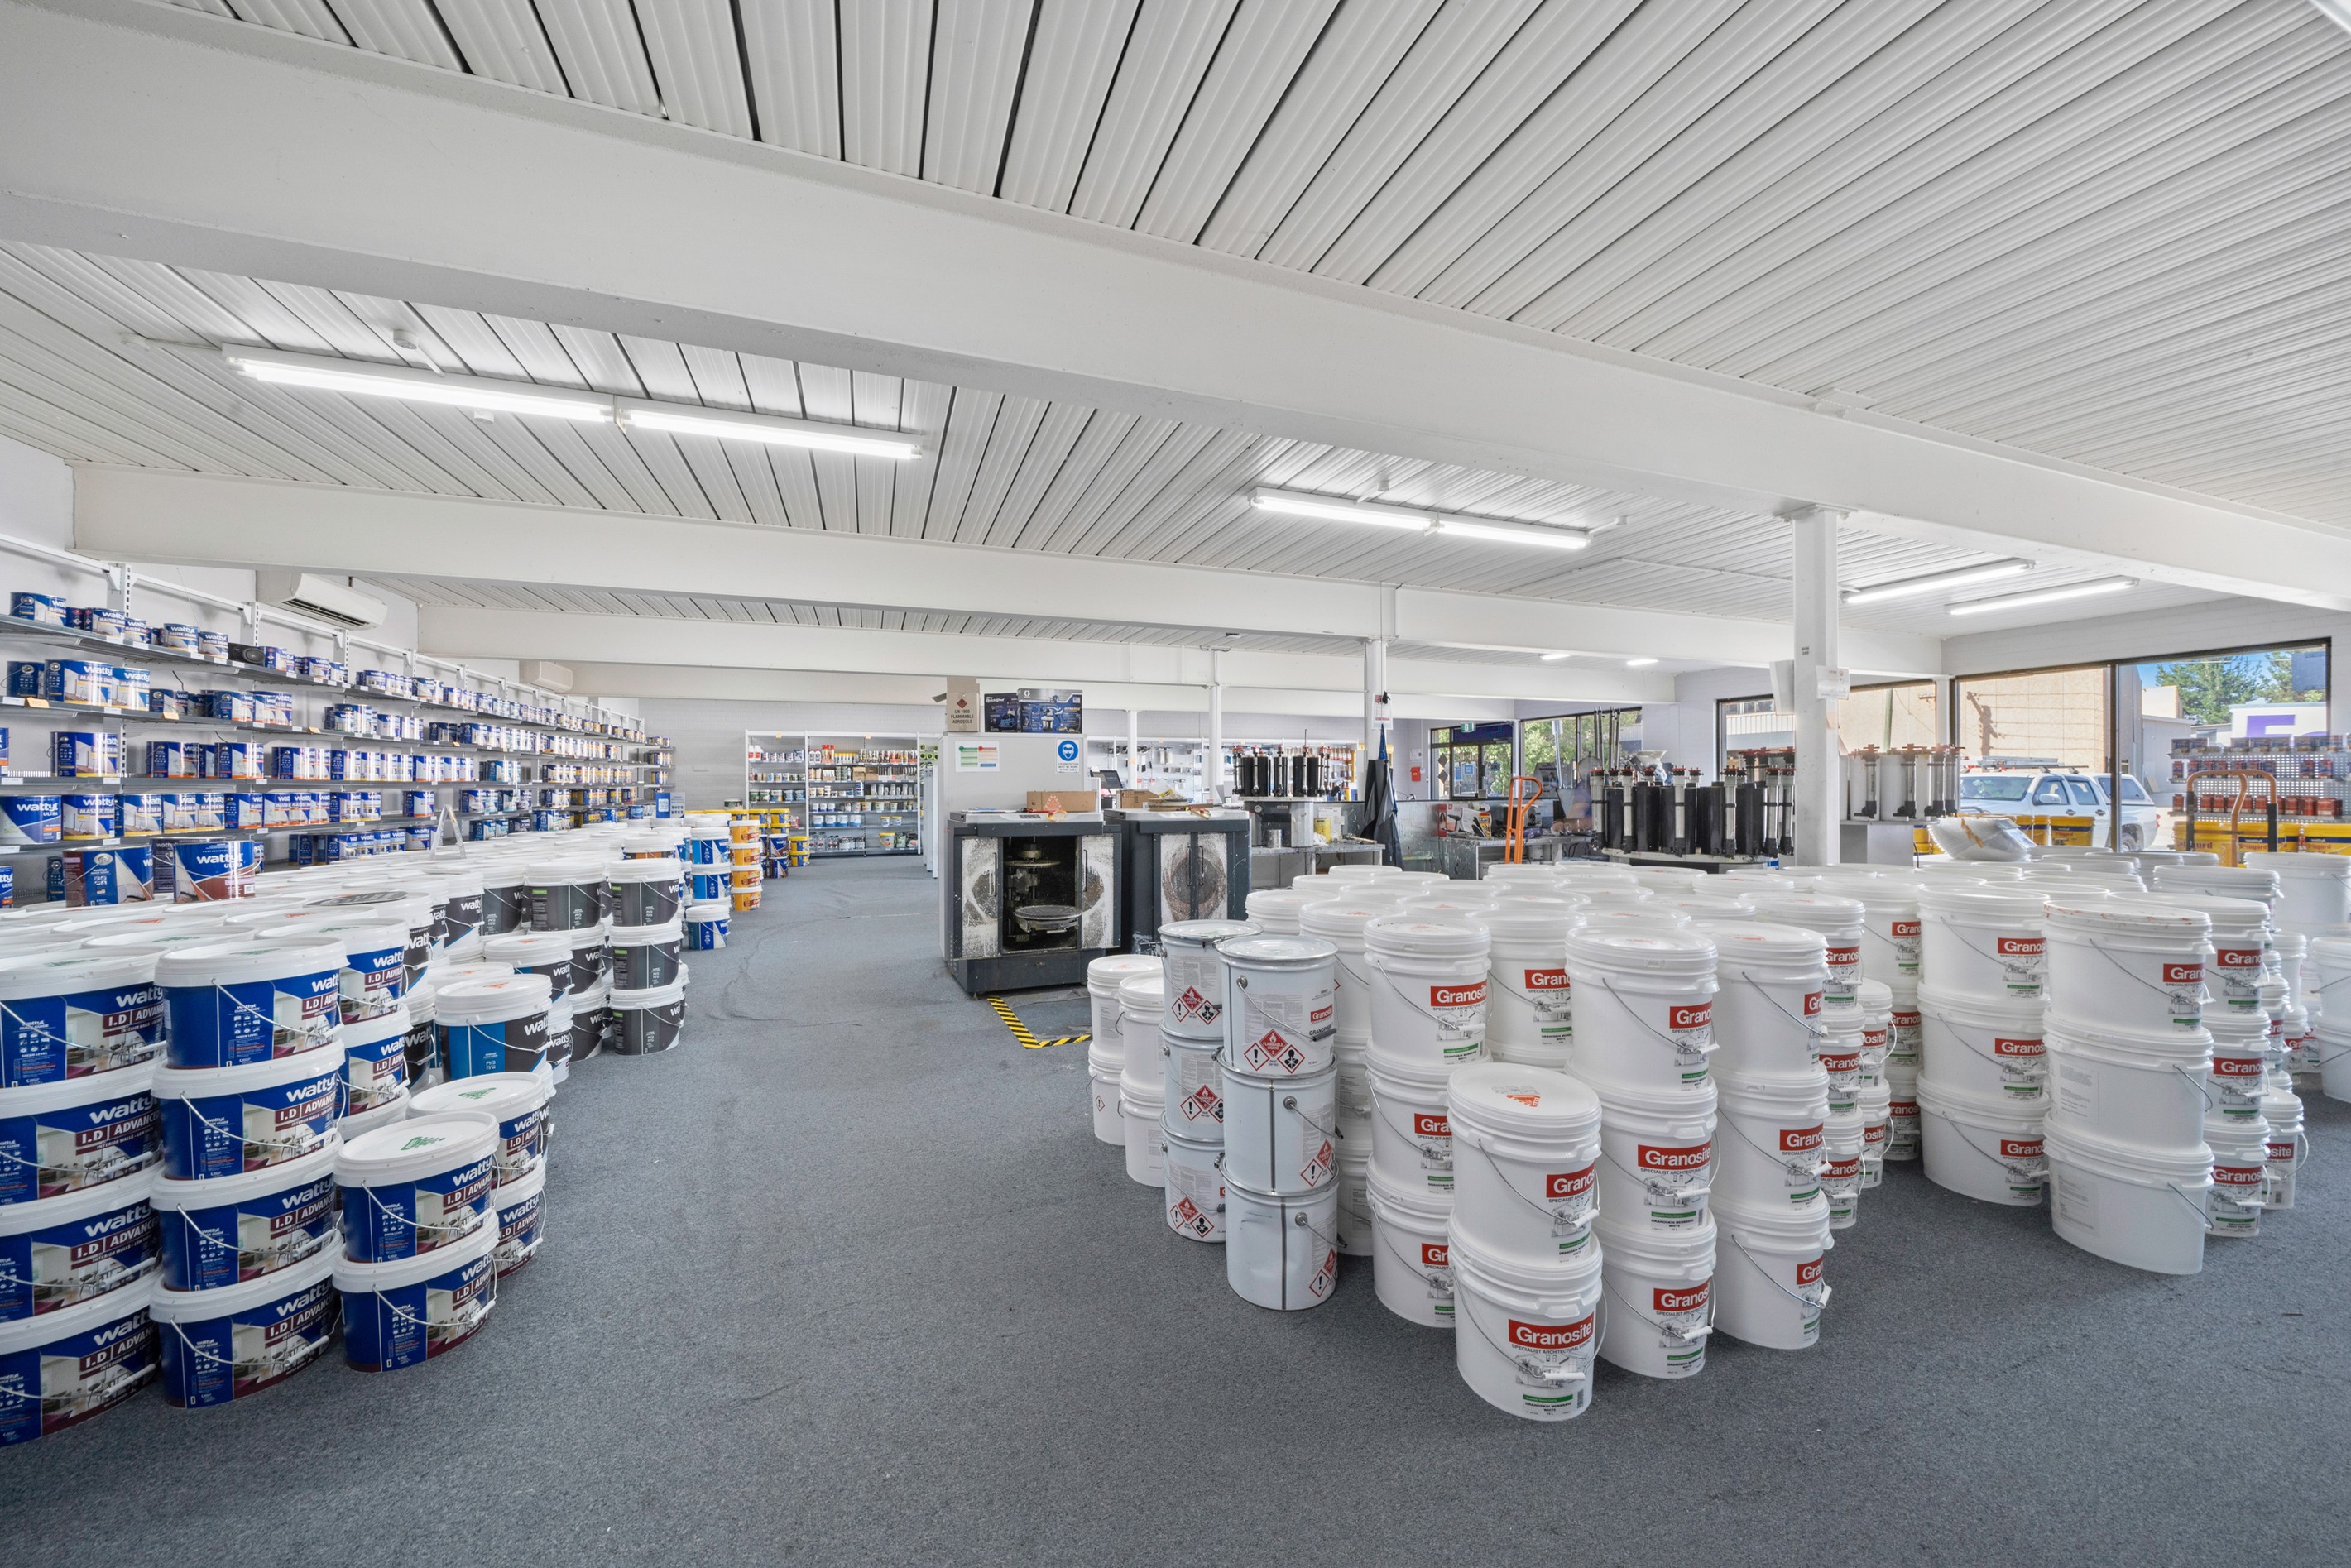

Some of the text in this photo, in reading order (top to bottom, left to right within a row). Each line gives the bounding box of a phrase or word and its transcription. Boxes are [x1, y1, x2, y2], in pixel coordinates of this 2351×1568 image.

[17, 802, 58, 811] wattyl
[368, 973, 381, 983] I.D
[306, 999, 319, 1010] I.D
[108, 1014, 127, 1026] I.D
[376, 1061, 388, 1071] I.D
[286, 1073, 336, 1103] wattyl
[280, 1108, 297, 1121] I.D
[82, 1130, 103, 1144] I.D
[510, 1138, 521, 1148] I.D
[447, 1192, 461, 1204] I.D
[275, 1215, 293, 1228] I.D
[77, 1242, 99, 1258] I.D
[456, 1287, 470, 1300] I.D
[270, 1322, 288, 1338] I.D
[1516, 1322, 1592, 1345] Granosite
[1511, 1343, 1579, 1355] SPECIALIST ARCHITECTURAL
[86, 1352, 107, 1368] I.D
